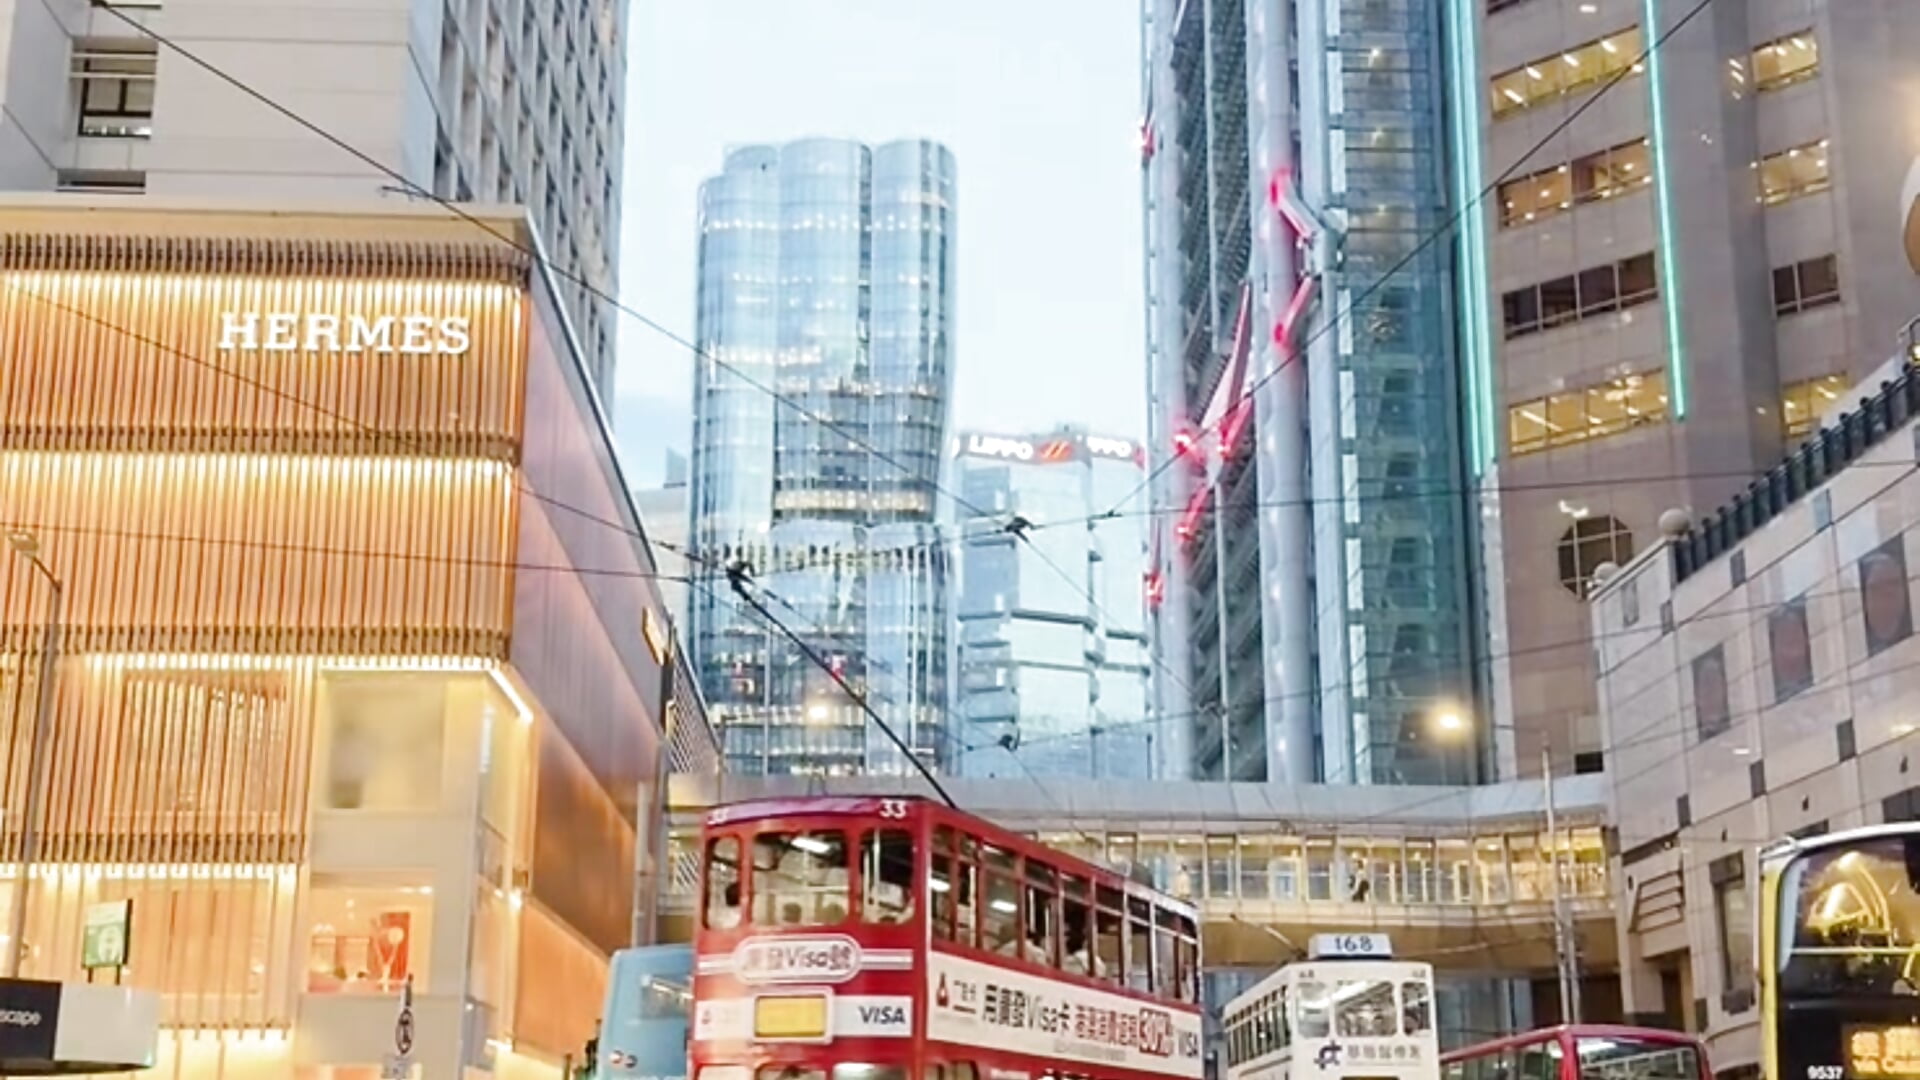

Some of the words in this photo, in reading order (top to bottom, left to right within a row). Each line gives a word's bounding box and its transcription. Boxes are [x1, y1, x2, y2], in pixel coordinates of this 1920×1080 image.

[880, 800, 907, 818] 33
[1334, 935, 1374, 951] 168
[859, 1006, 906, 1024] VISA
